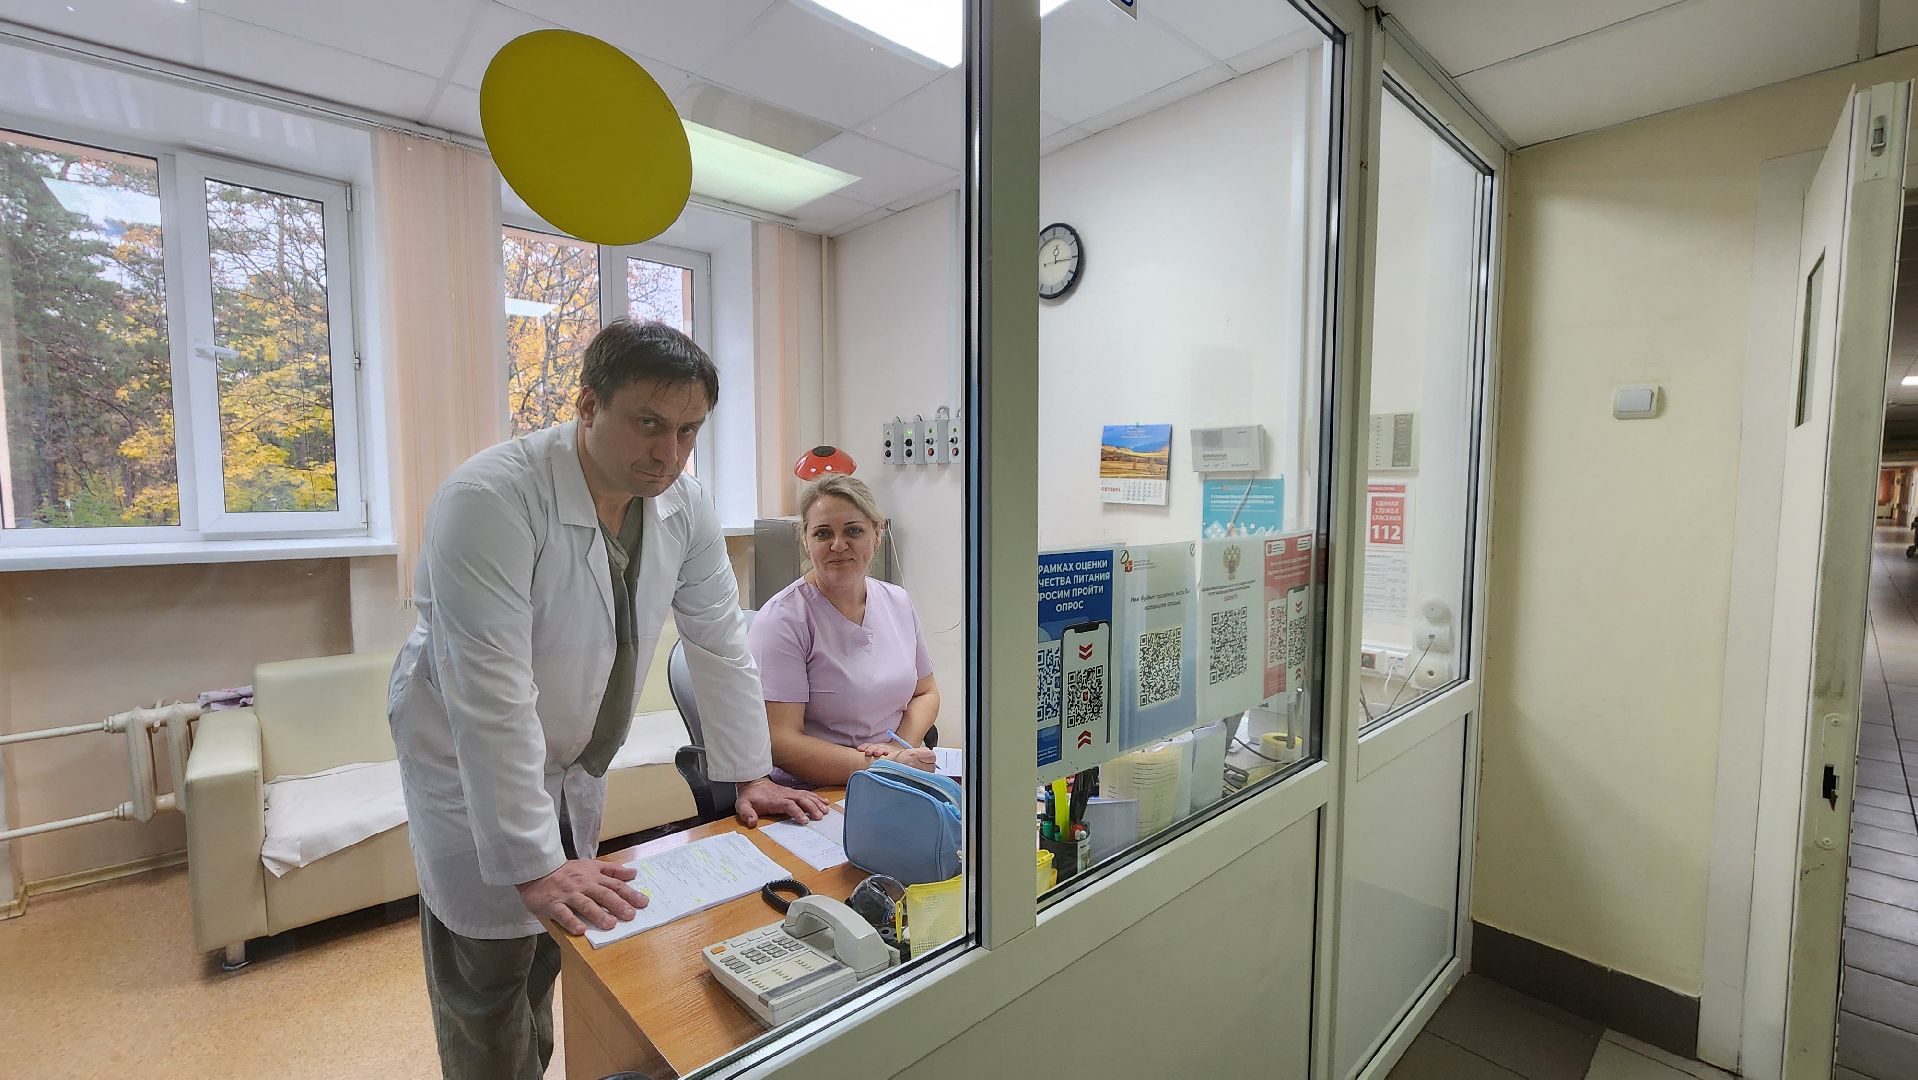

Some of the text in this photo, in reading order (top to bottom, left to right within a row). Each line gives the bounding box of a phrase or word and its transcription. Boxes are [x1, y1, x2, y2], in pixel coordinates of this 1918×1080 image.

[1375, 500, 1399, 508] ЕДИНАЯ
[1375, 507, 1399, 515] СЛУЖБА
[1371, 525, 1401, 540] 112
[1038, 560, 1108, 574] РАМКАХ ОЦЕНКИ
[1073, 572, 1111, 584] ПИТАНИЯ
[1038, 585, 1104, 601] РОСИМ ПРОЙТИ
[1141, 594, 1155, 602] будет
[1055, 600, 1084, 612] ОПРОС
